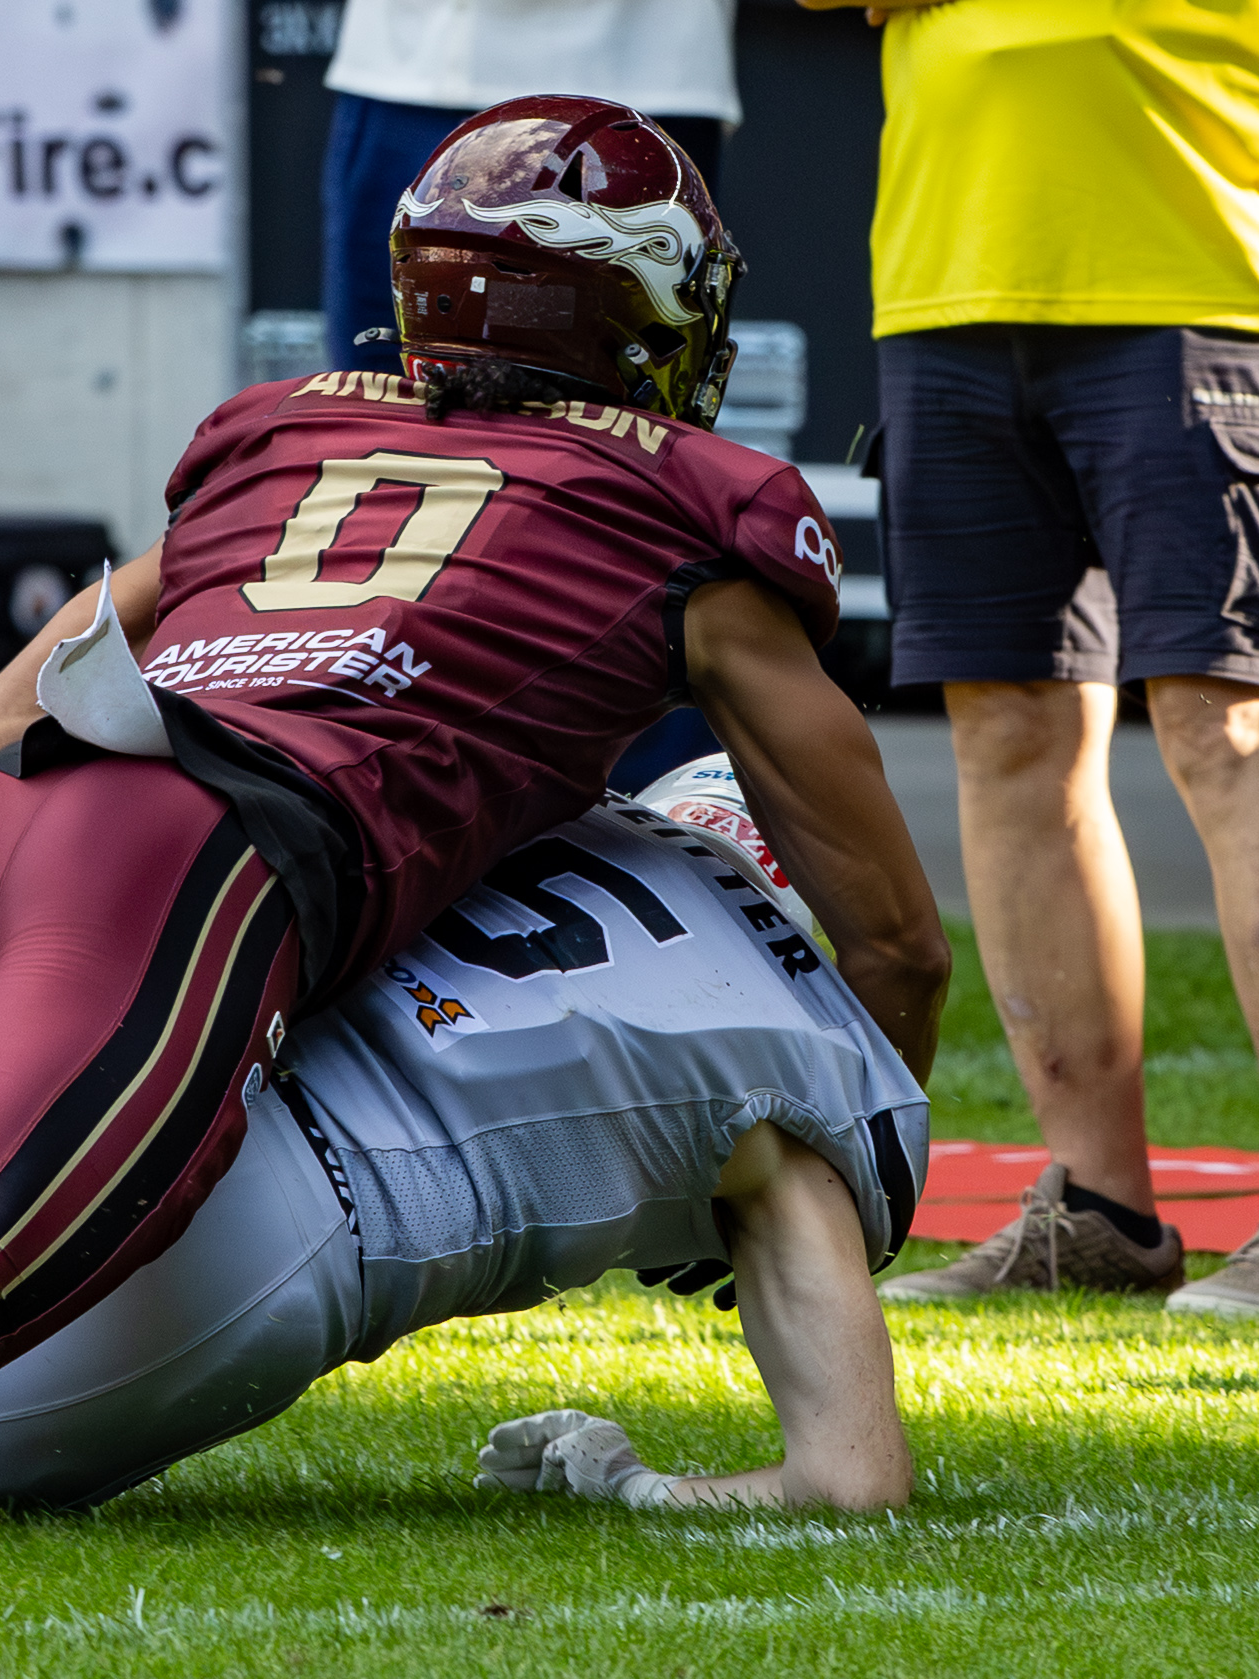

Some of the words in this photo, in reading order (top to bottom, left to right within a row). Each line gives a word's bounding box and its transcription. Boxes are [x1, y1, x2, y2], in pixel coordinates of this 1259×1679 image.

[289, 370, 670, 455] ANDSON
[238, 448, 509, 614] 0
[145, 627, 432, 678] AMERICAN
[206, 677, 246, 691] SINCE
[249, 676, 285, 688] 1933
